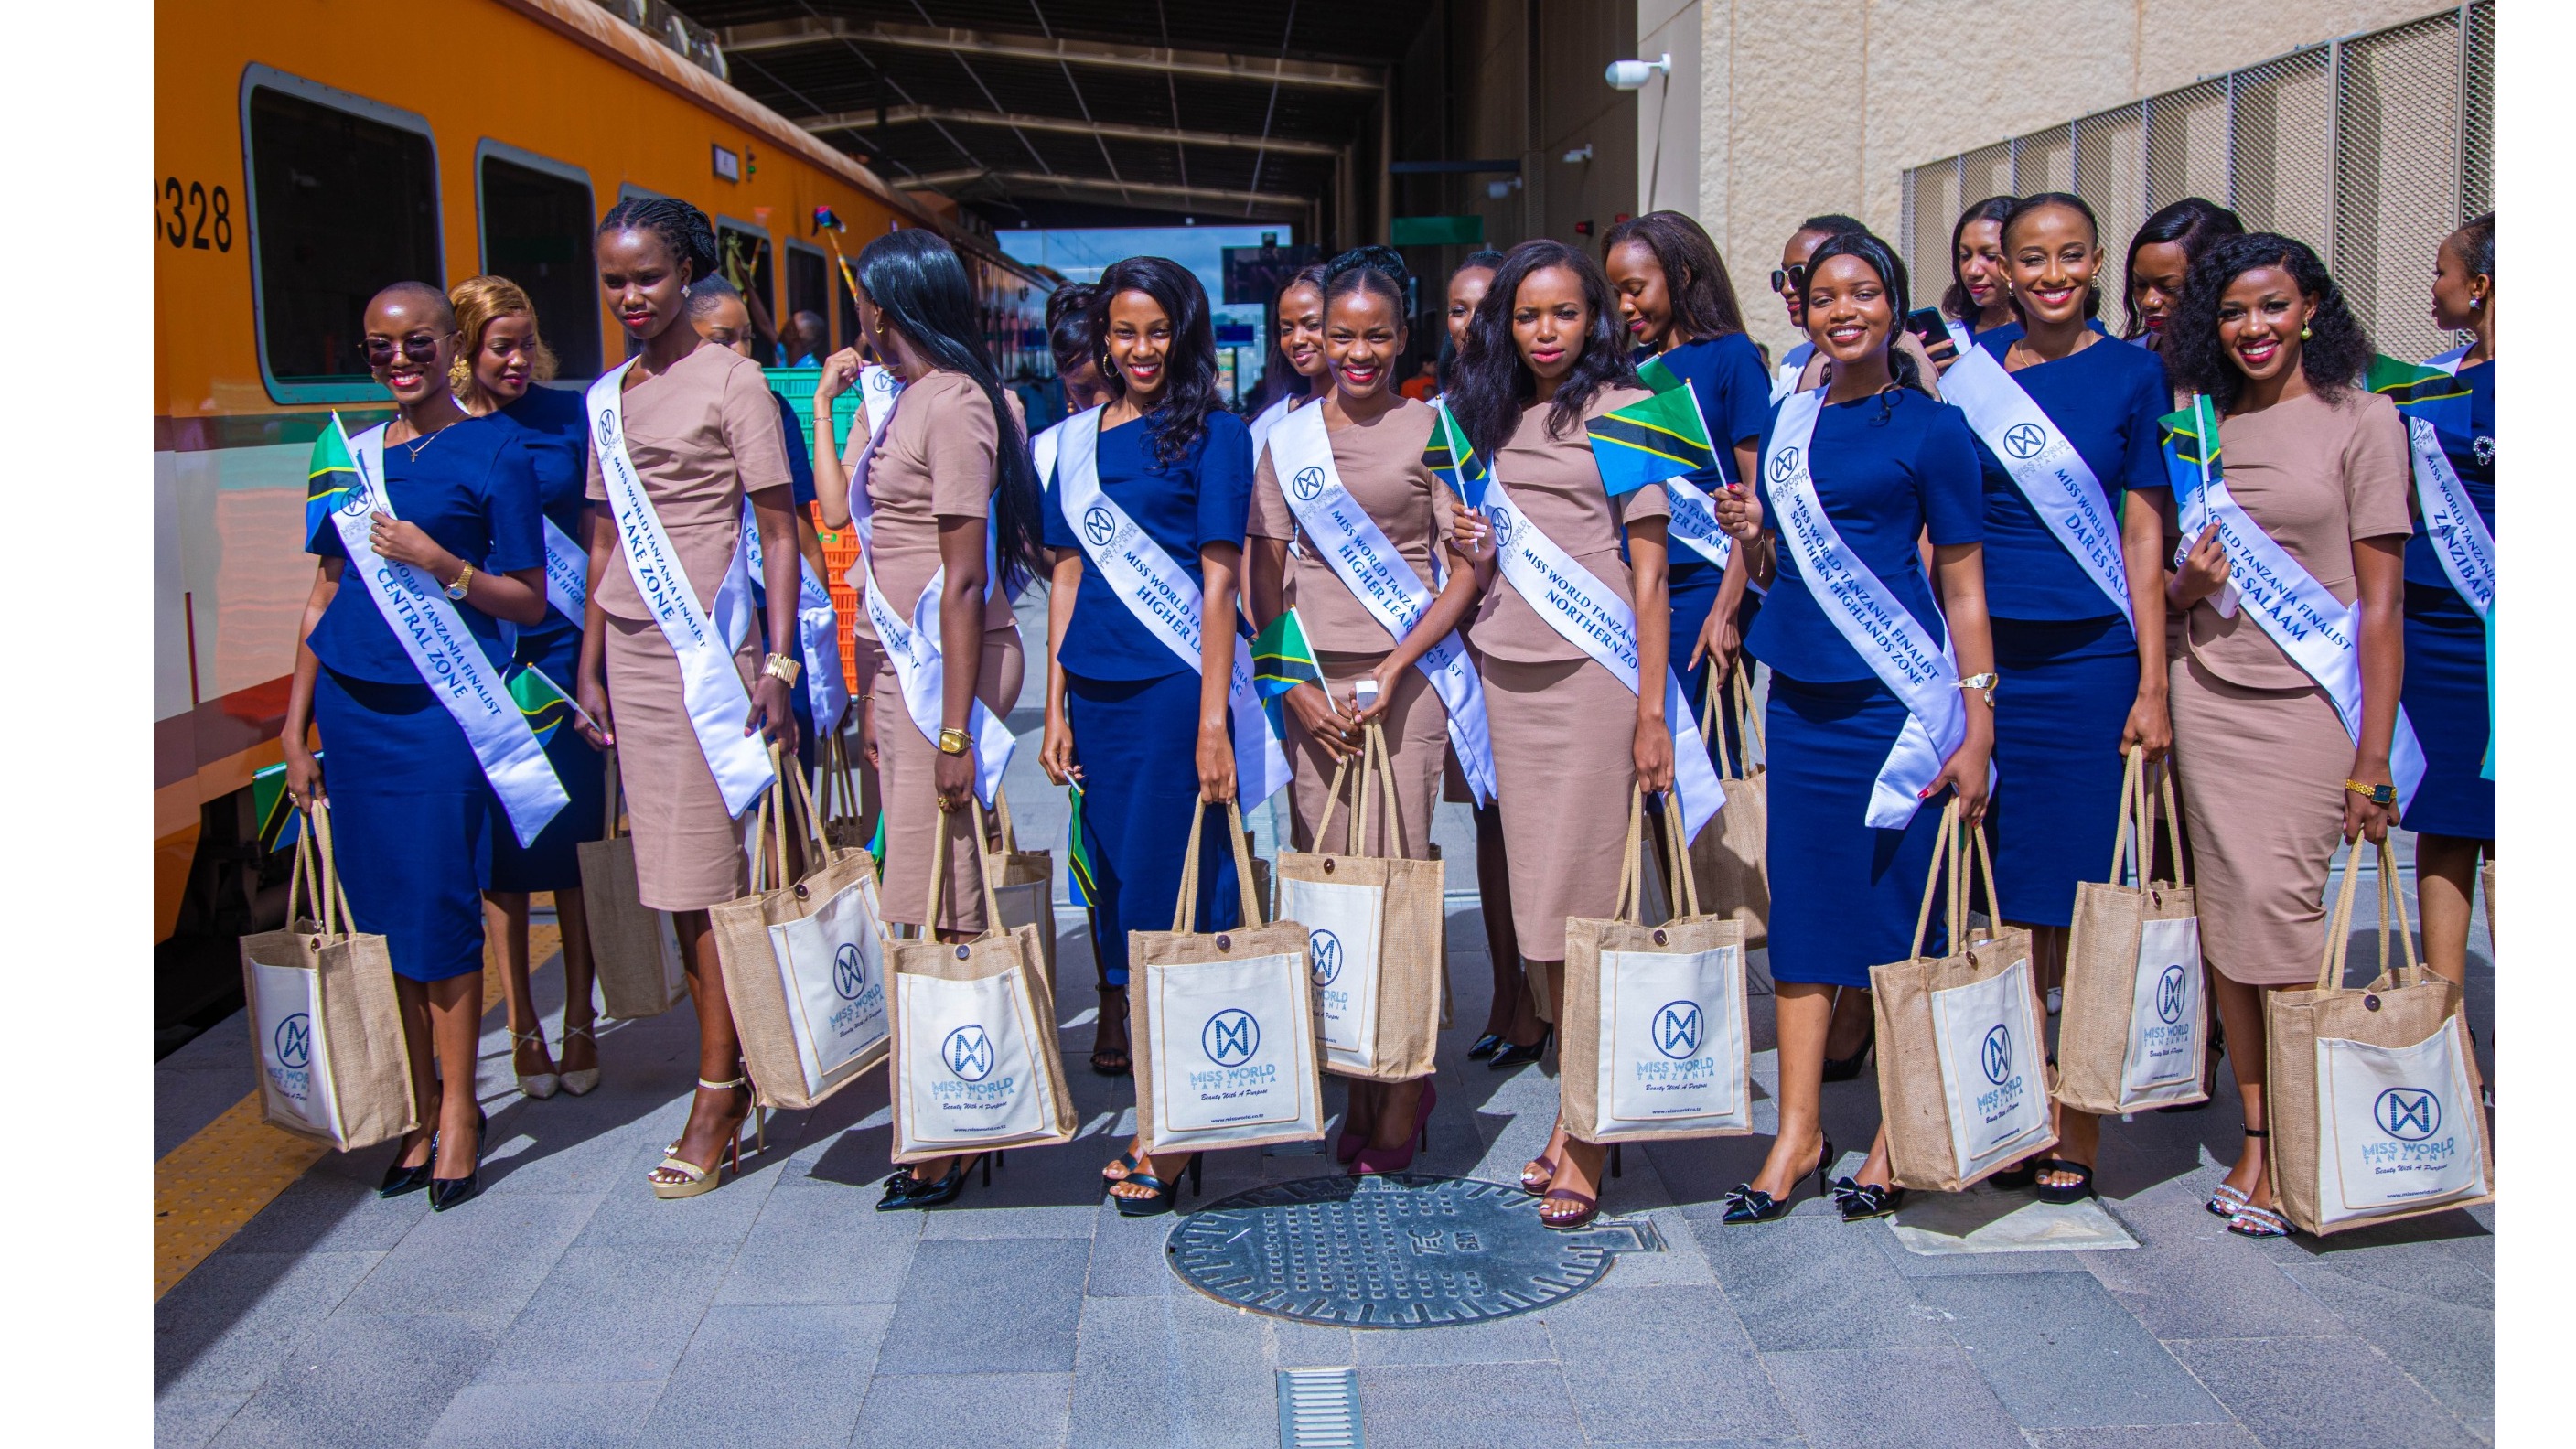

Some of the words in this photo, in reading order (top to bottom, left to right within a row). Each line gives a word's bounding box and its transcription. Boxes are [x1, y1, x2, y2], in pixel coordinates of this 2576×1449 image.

[1783, 467, 1808, 488] WORLD
[2425, 455, 2442, 481] MISS
[2440, 480, 2465, 526] WORLD
[1109, 522, 1134, 548] WORLD
[1690, 523, 1731, 555] LEARN
[2055, 468, 2082, 498] MISS
[2077, 495, 2106, 538] WORLD
[2103, 536, 2124, 574] TANZA
[614, 456, 628, 485] MISS
[627, 485, 649, 531] WORLD
[647, 531, 677, 594] TANZANIA
[675, 594, 707, 648] FINALIST
[622, 510, 648, 563] LAKE
[640, 563, 675, 620] ZONE
[2064, 512, 2096, 552] DAR
[2091, 547, 2109, 569] ES
[2105, 565, 2131, 606] SALA
[2433, 509, 2492, 603] ZANZIBAR
[1123, 550, 1151, 577] MISS
[1150, 574, 1189, 616] WORLD
[1332, 510, 1357, 537] MISS
[1352, 535, 1388, 577] WORLD
[1385, 575, 1422, 620] TANZAN
[1435, 644, 1464, 677] ALIST
[1338, 543, 1385, 601] HIGHER
[1382, 598, 1414, 632] LEAR
[1522, 548, 1549, 574] MISS
[1548, 569, 1591, 608] WORLD
[1790, 510, 1834, 583] SOUTHERN
[1830, 582, 1895, 653] HIGHLANDS
[1890, 651, 1925, 686] ZONE
[1794, 494, 1812, 524] MISS
[1809, 524, 1842, 571] WORLD
[1841, 570, 1893, 631] TANZANIA
[1891, 628, 1939, 681] FINALIST
[2240, 547, 2299, 605] TANZANIA
[2297, 602, 2355, 652] FINALIST
[377, 568, 436, 650] CENTRAL
[426, 649, 469, 699] ZONE
[1136, 585, 1190, 640] HIGHER
[1545, 589, 1623, 654] NORTHERN
[1621, 649, 1639, 673] ZO
[2241, 578, 2309, 643] SALAAM
[422, 601, 464, 666] TANZANIA
[460, 663, 502, 716] FINALIST
[829, 1004, 853, 1026] MISS
[854, 983, 881, 1009] WORLD
[2144, 1026, 2165, 1039] MISS
[2167, 1024, 2189, 1036] WORLD
[2144, 1035, 2188, 1047] TANZANIA
[286, 1069, 309, 1084] WOR
[932, 1080, 964, 1093] MISS
[965, 1077, 1014, 1094] WORLD
[1189, 1070, 1224, 1083] MISS
[1226, 1064, 1276, 1079] WORLD
[1191, 1075, 1277, 1090] TANZANIA
[1637, 1061, 1669, 1074] MISS
[1674, 1057, 1714, 1072] WORLD
[1637, 1068, 1714, 1081] TANZANIA
[1646, 1084, 1665, 1092] Beauty
[933, 1087, 1015, 1100] TANZANIA
[1977, 1089, 1999, 1110] MISS
[2000, 1075, 2022, 1096] WORLD
[2362, 1142, 2397, 1155] MISS
[2402, 1137, 2454, 1154] WORLD
[2364, 1149, 2455, 1165] TANZANIA
[2375, 1166, 2396, 1175] Beauty
